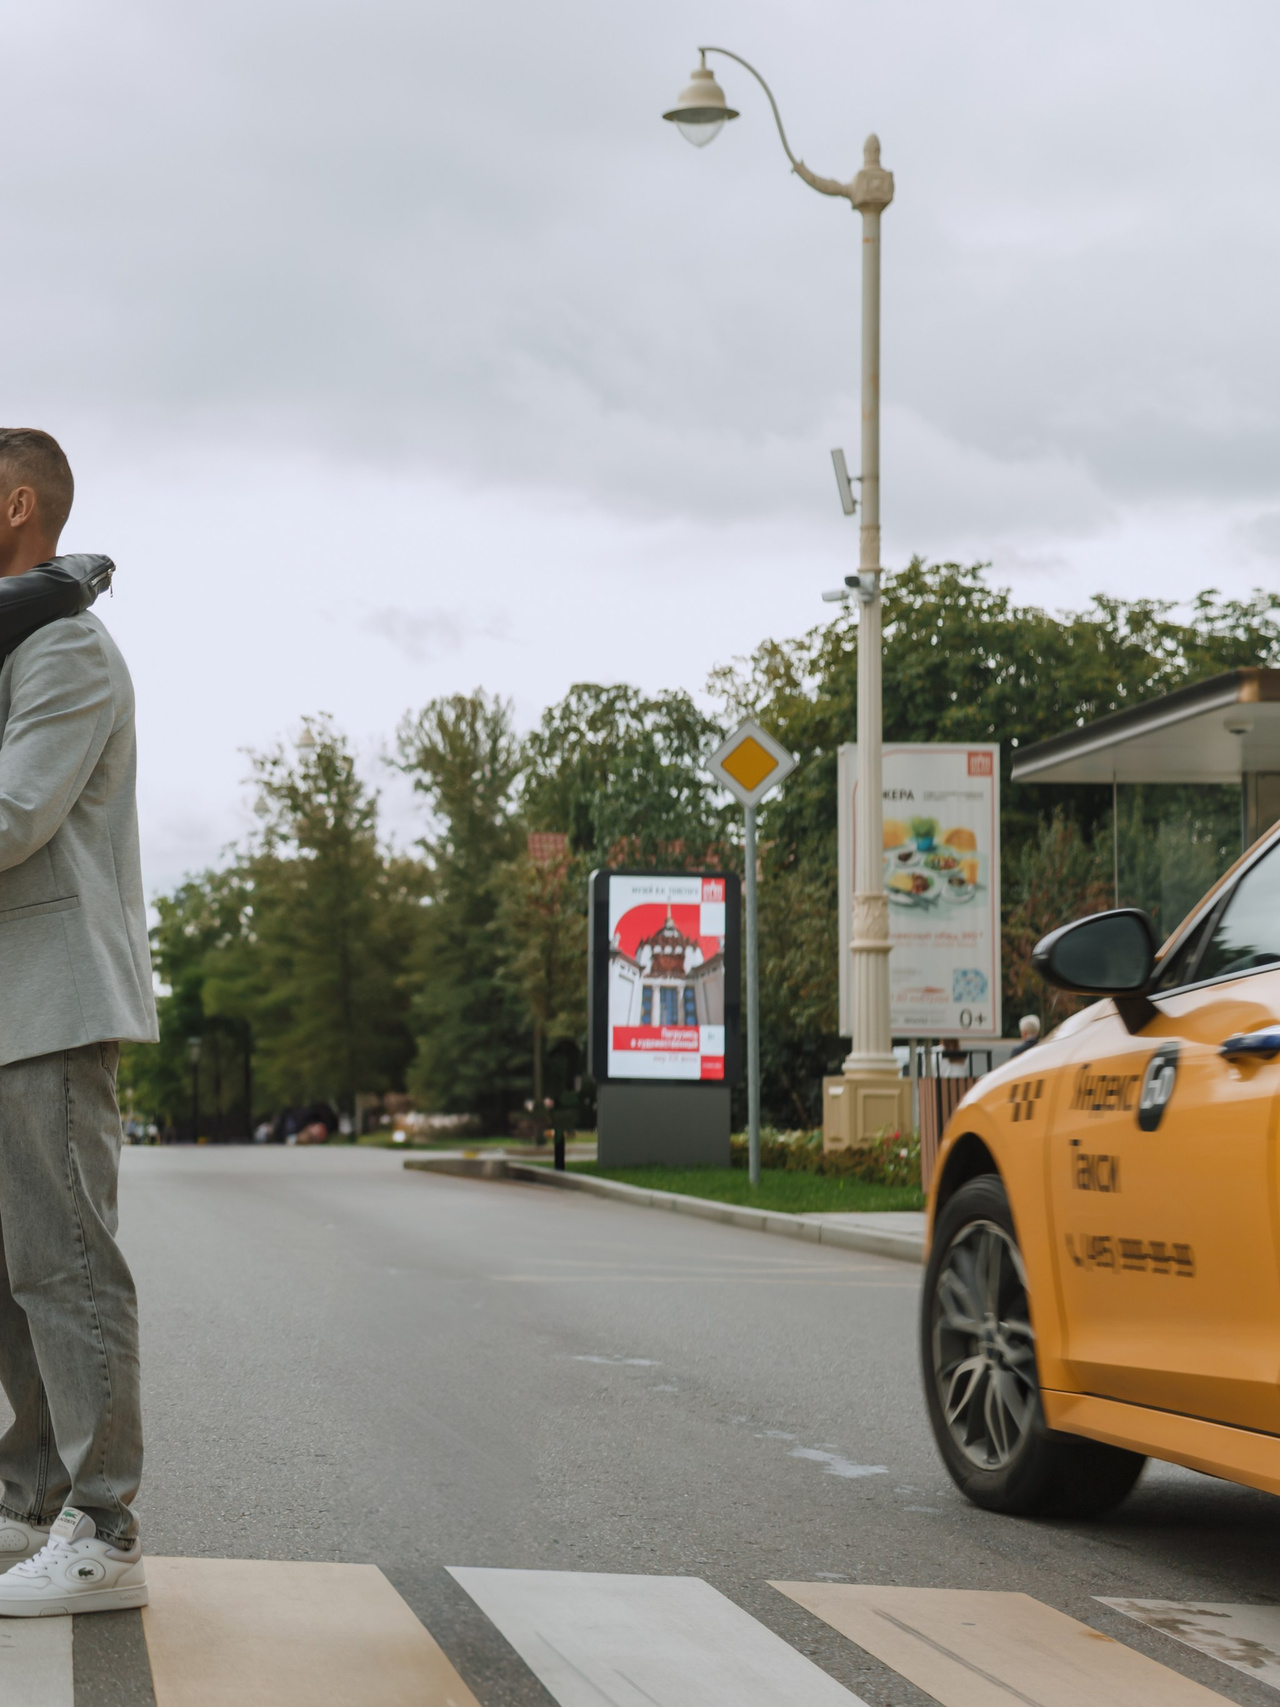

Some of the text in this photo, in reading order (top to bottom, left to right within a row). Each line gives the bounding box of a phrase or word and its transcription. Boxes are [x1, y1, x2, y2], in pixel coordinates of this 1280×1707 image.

[960, 1008, 987, 1030] 0+
[1070, 1063, 1141, 1118] Яндекс
[1069, 1139, 1121, 1193] Такси
